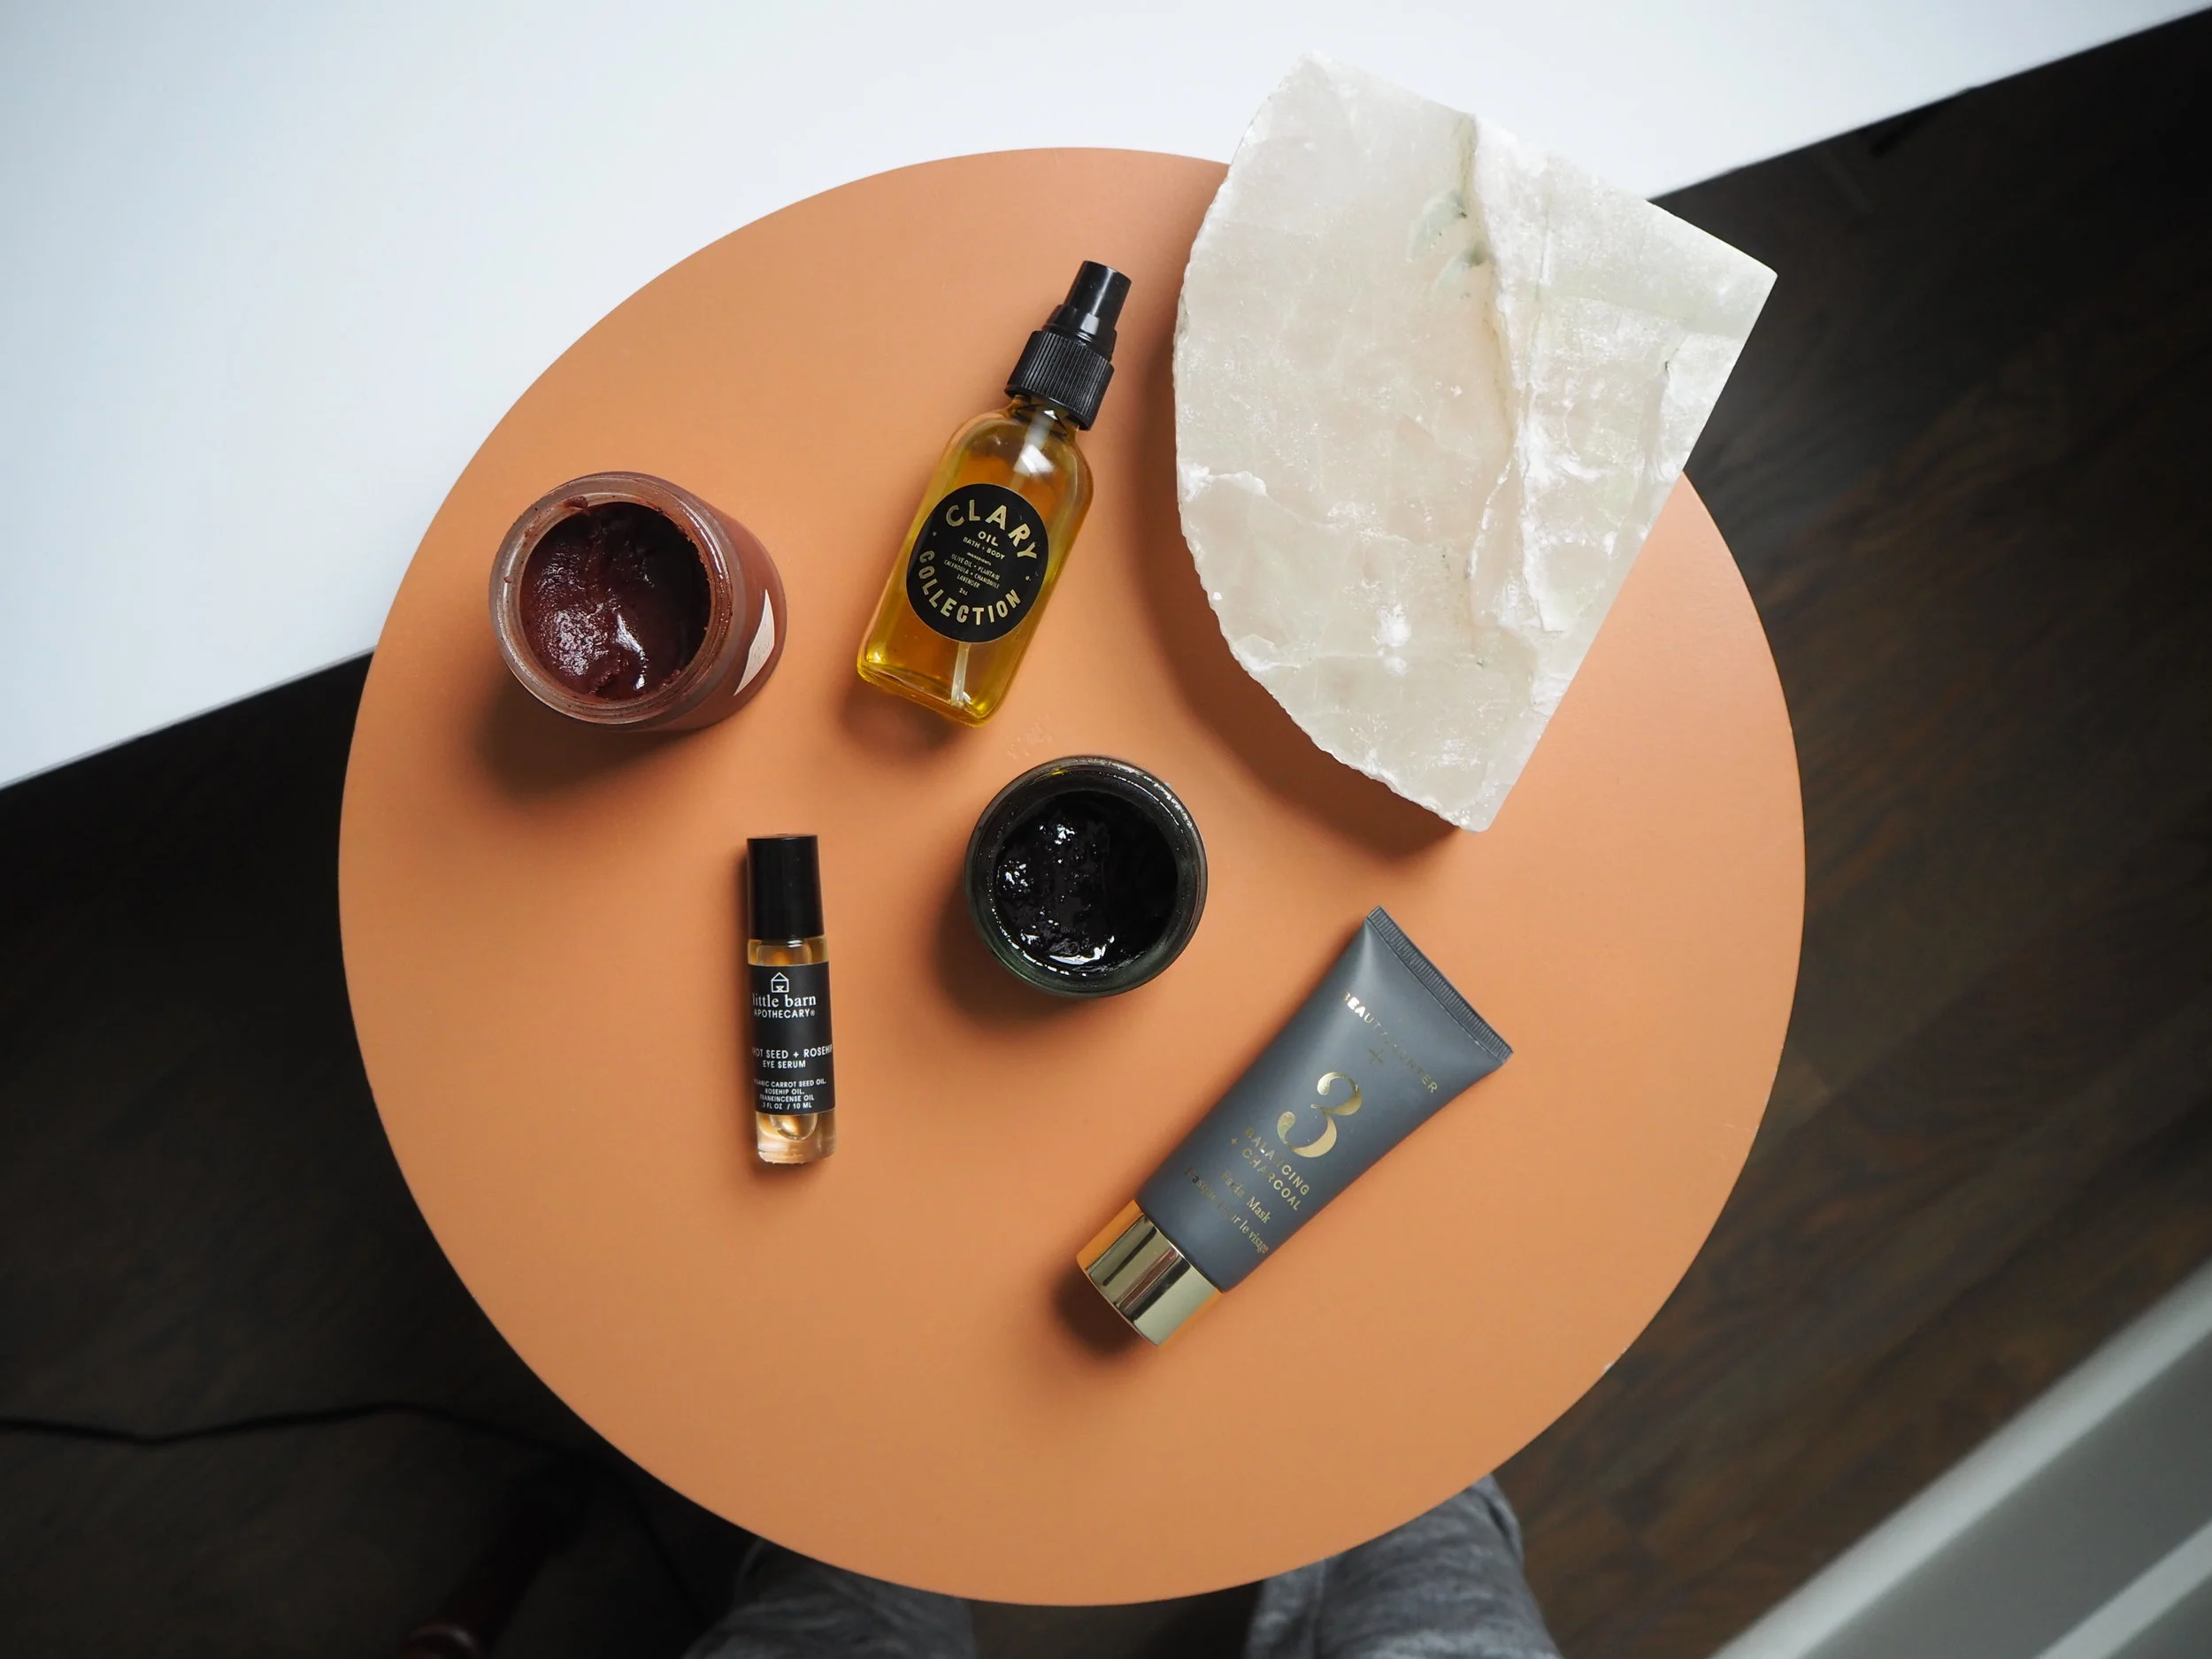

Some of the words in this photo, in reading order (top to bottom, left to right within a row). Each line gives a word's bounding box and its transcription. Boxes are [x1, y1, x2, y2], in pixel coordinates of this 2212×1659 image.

[946, 500, 1037, 559] CLARY
[978, 531, 998, 547] OIL
[963, 536, 980, 549] BATH
[987, 548, 1005, 560] BODY
[951, 554, 964, 564] OLIVE
[977, 566, 1000, 580] PLANTAIN
[918, 550, 1021, 626] COLLECTION
[956, 574, 980, 588] LAVENDER
[752, 993, 780, 1008] little
[785, 995, 817, 1007] barn
[766, 1049, 789, 1059] SEED
[778, 1060, 806, 1069] SERUM
[1277, 1071, 1363, 1158] 3
[1241, 1148, 1301, 1211] CHARCOAL
[1247, 1195, 1271, 1224] Mask
[1239, 1220, 1249, 1233] le
[1248, 1231, 1270, 1254] visage
